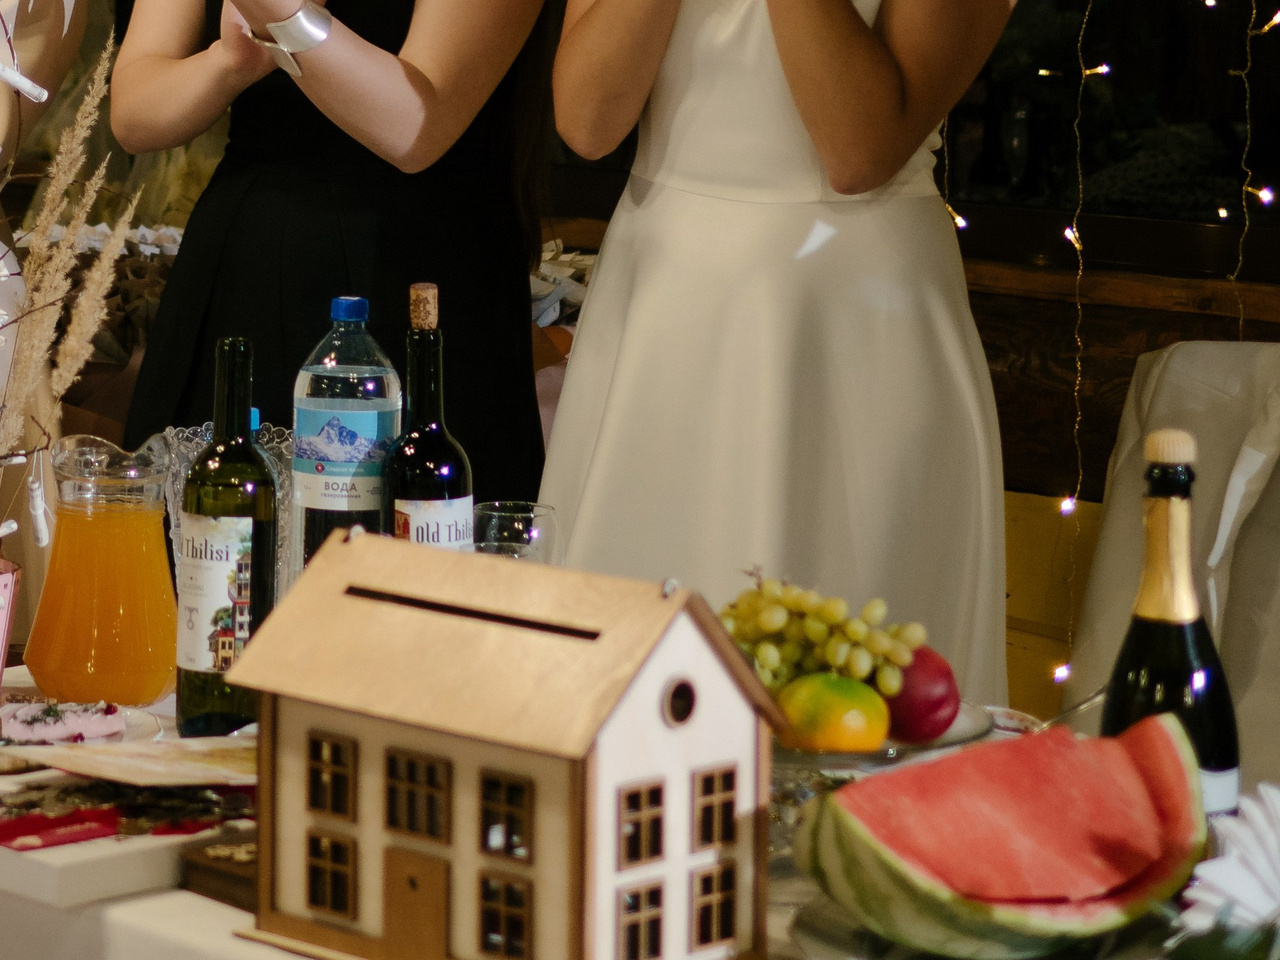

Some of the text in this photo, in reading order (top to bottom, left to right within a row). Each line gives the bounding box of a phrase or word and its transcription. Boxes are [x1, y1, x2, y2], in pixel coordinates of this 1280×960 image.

[324, 481, 358, 493] ВОДА
[416, 521, 440, 543] Old
[185, 535, 230, 561] Tbilisi
